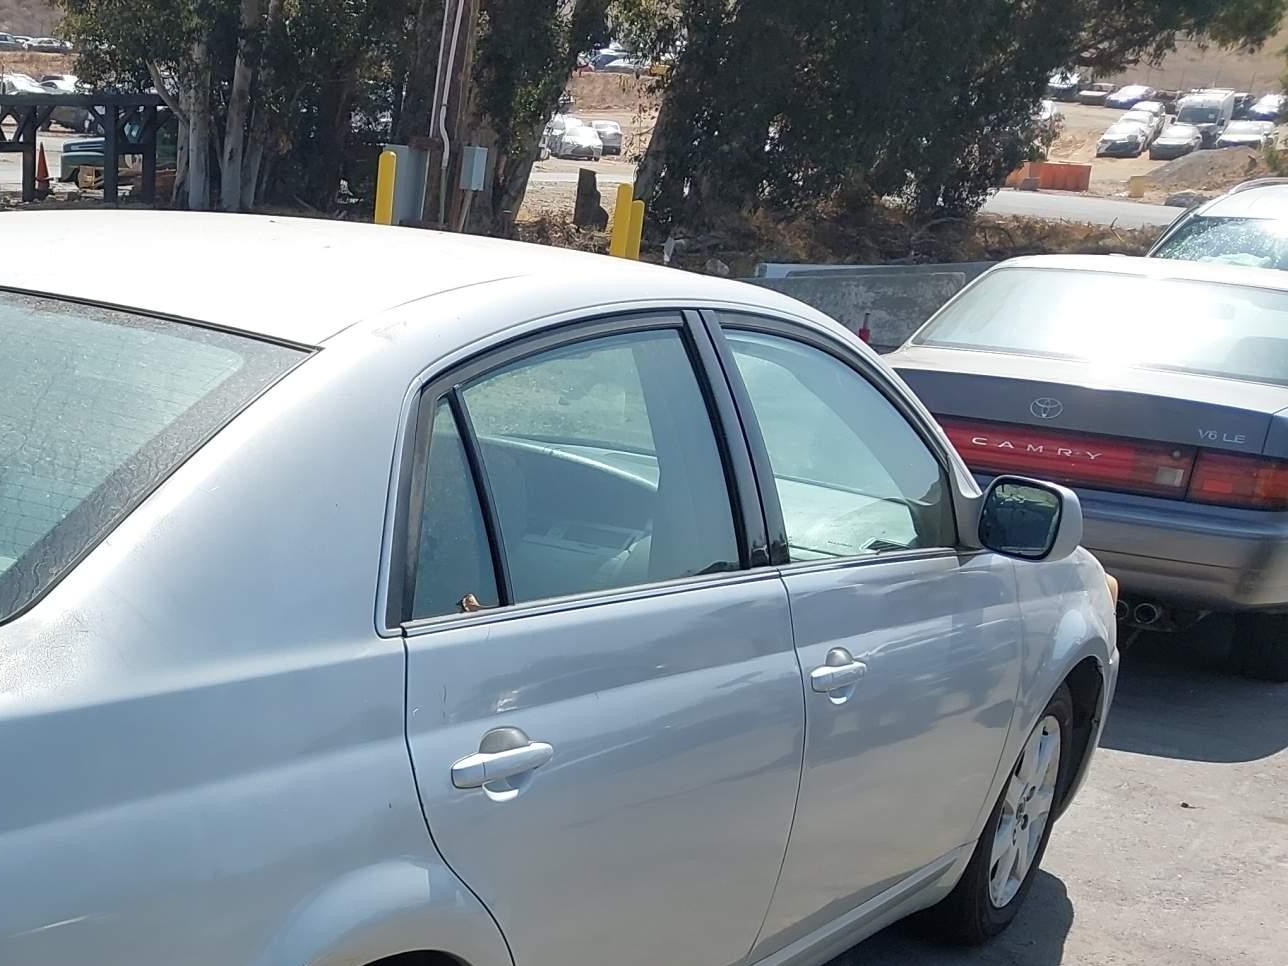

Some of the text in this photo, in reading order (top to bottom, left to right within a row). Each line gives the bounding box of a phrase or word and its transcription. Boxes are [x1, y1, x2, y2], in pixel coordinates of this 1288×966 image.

[1198, 428, 1247, 444] V6 LE
[972, 436, 1103, 460] CAMRY
